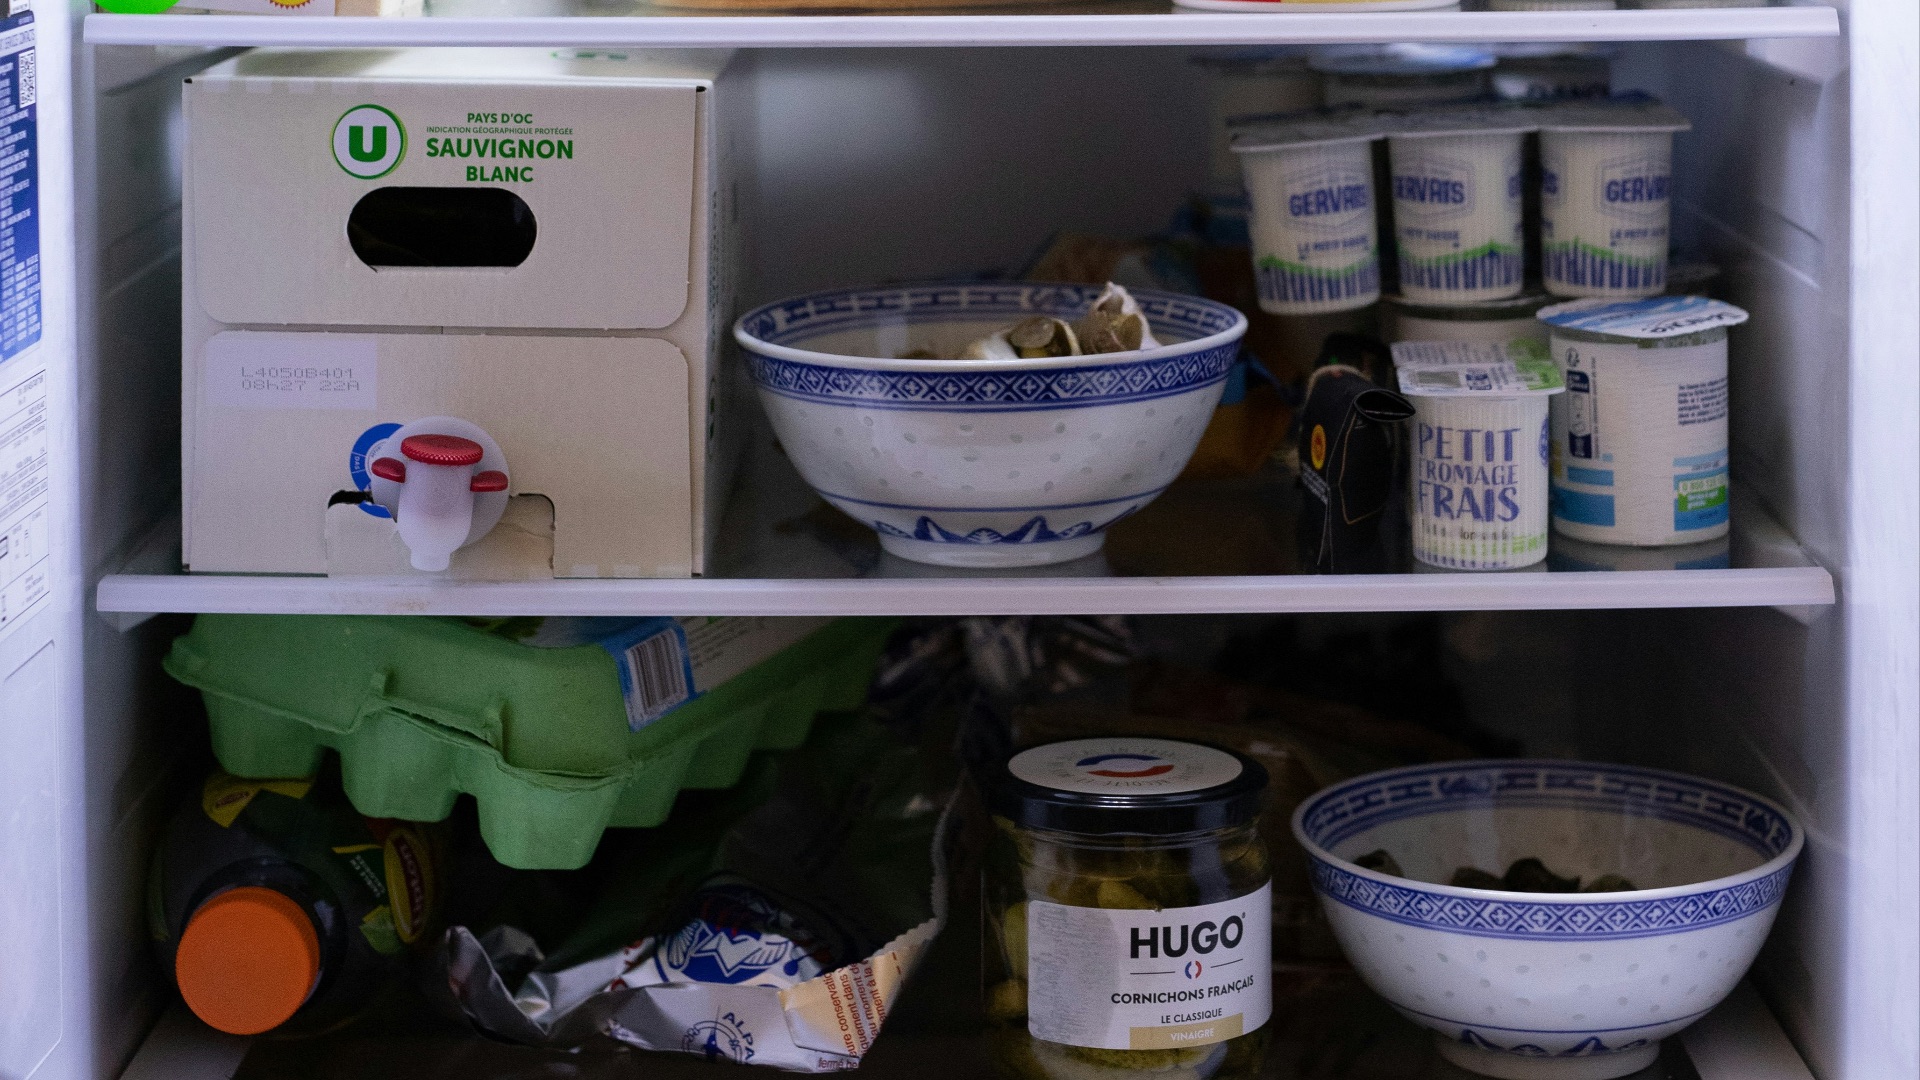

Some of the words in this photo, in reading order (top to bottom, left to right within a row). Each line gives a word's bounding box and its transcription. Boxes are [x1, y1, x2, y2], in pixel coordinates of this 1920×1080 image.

[426, 126, 472, 134] INDICATION
[472, 126, 533, 135] GÉOGRAPHIQUE
[534, 126, 574, 136] PROTÉGÉE
[467, 113, 497, 124] PAYS
[501, 113, 533, 124] D'OC
[348, 125, 387, 163] U
[426, 138, 574, 160] SAUVIGNON
[466, 166, 534, 183] BLANC
[1418, 422, 1521, 462] PETIT
[1418, 458, 1519, 486] FROMAGE
[1418, 479, 1520, 523] FRAIS
[1130, 915, 1243, 959] HUGO
[840, 974, 854, 1001] dans
[857, 976, 874, 1020] moment
[1110, 988, 1205, 1005] CORNICHONS
[1207, 974, 1254, 997] FRANÇAIS
[1160, 1014, 1172, 1024] LE
[1173, 1007, 1223, 1024] CLASSIQUE
[722, 1011, 755, 1064] ALPA
